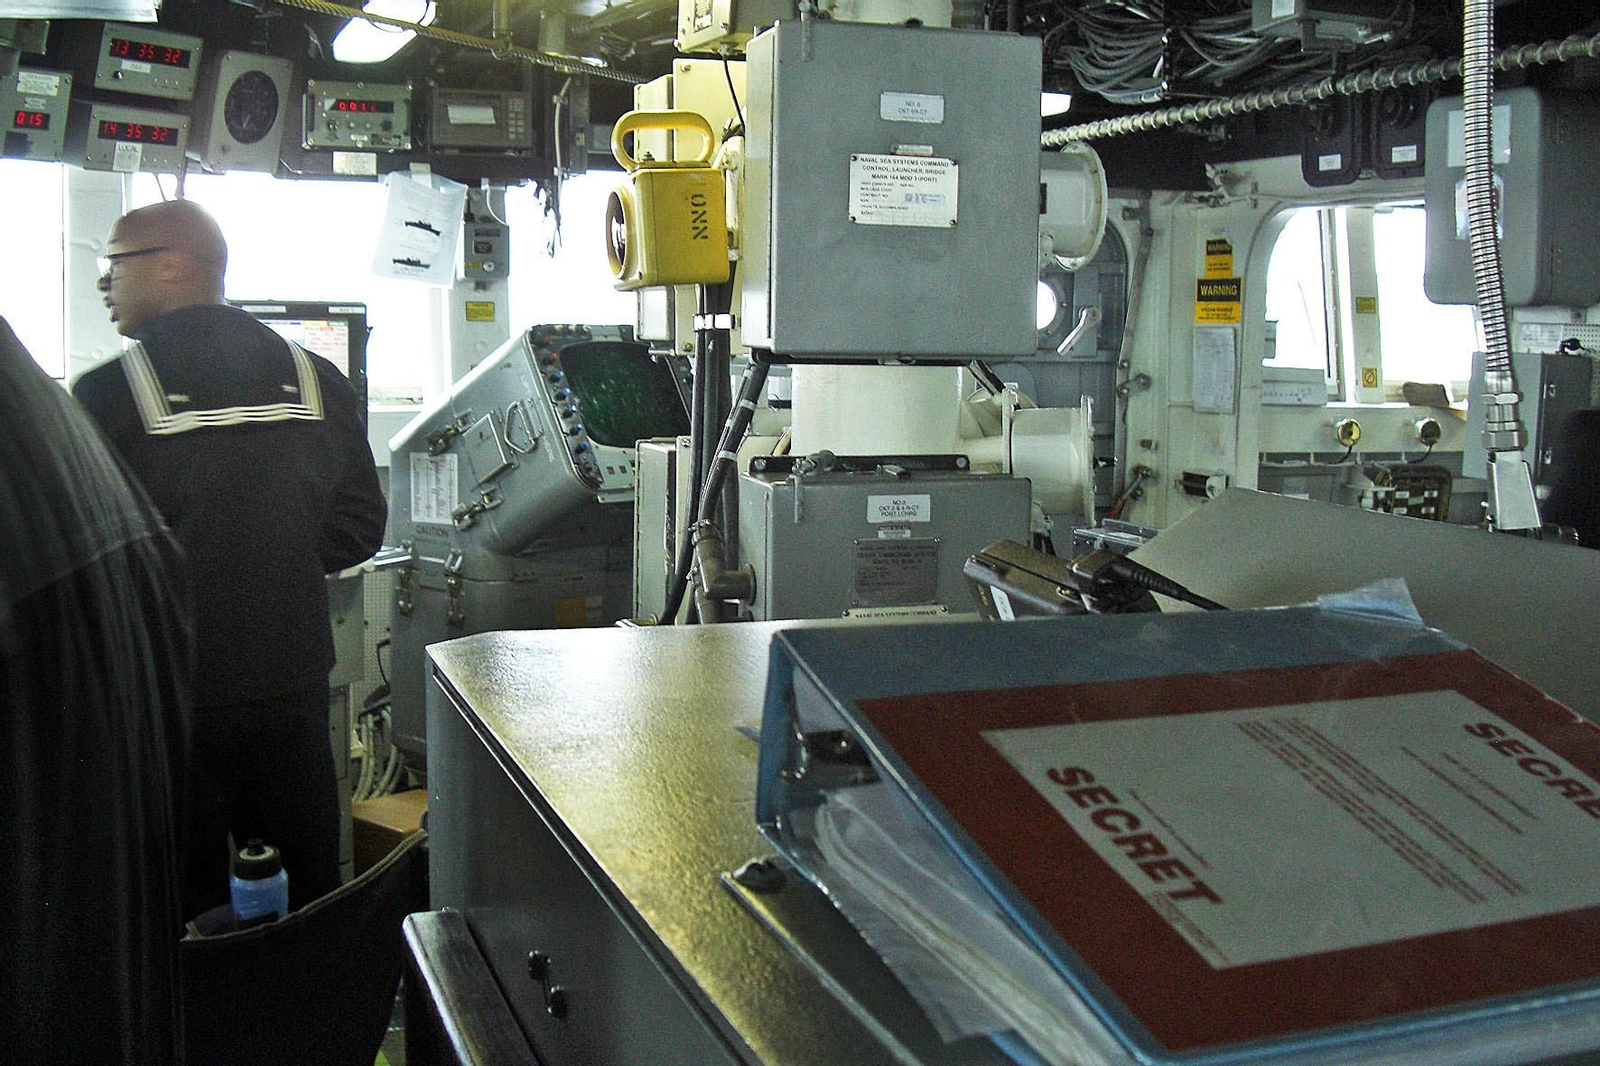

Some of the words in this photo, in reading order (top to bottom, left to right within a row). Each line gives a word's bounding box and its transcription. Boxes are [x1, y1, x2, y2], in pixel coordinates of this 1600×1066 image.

[115, 39, 130, 56] 13
[139, 43, 156, 59] 35
[164, 47, 182, 65] 32
[102, 122, 117, 136] 14
[126, 122, 142, 139] 35
[151, 126, 168, 142] 32
[118, 143, 138, 153] LOCAL
[1200, 284, 1238, 296] WARNING
[416, 525, 449, 537] CAUTION
[885, 610, 909, 618] SYSTEMS
[1046, 765, 1223, 905] SECRET
